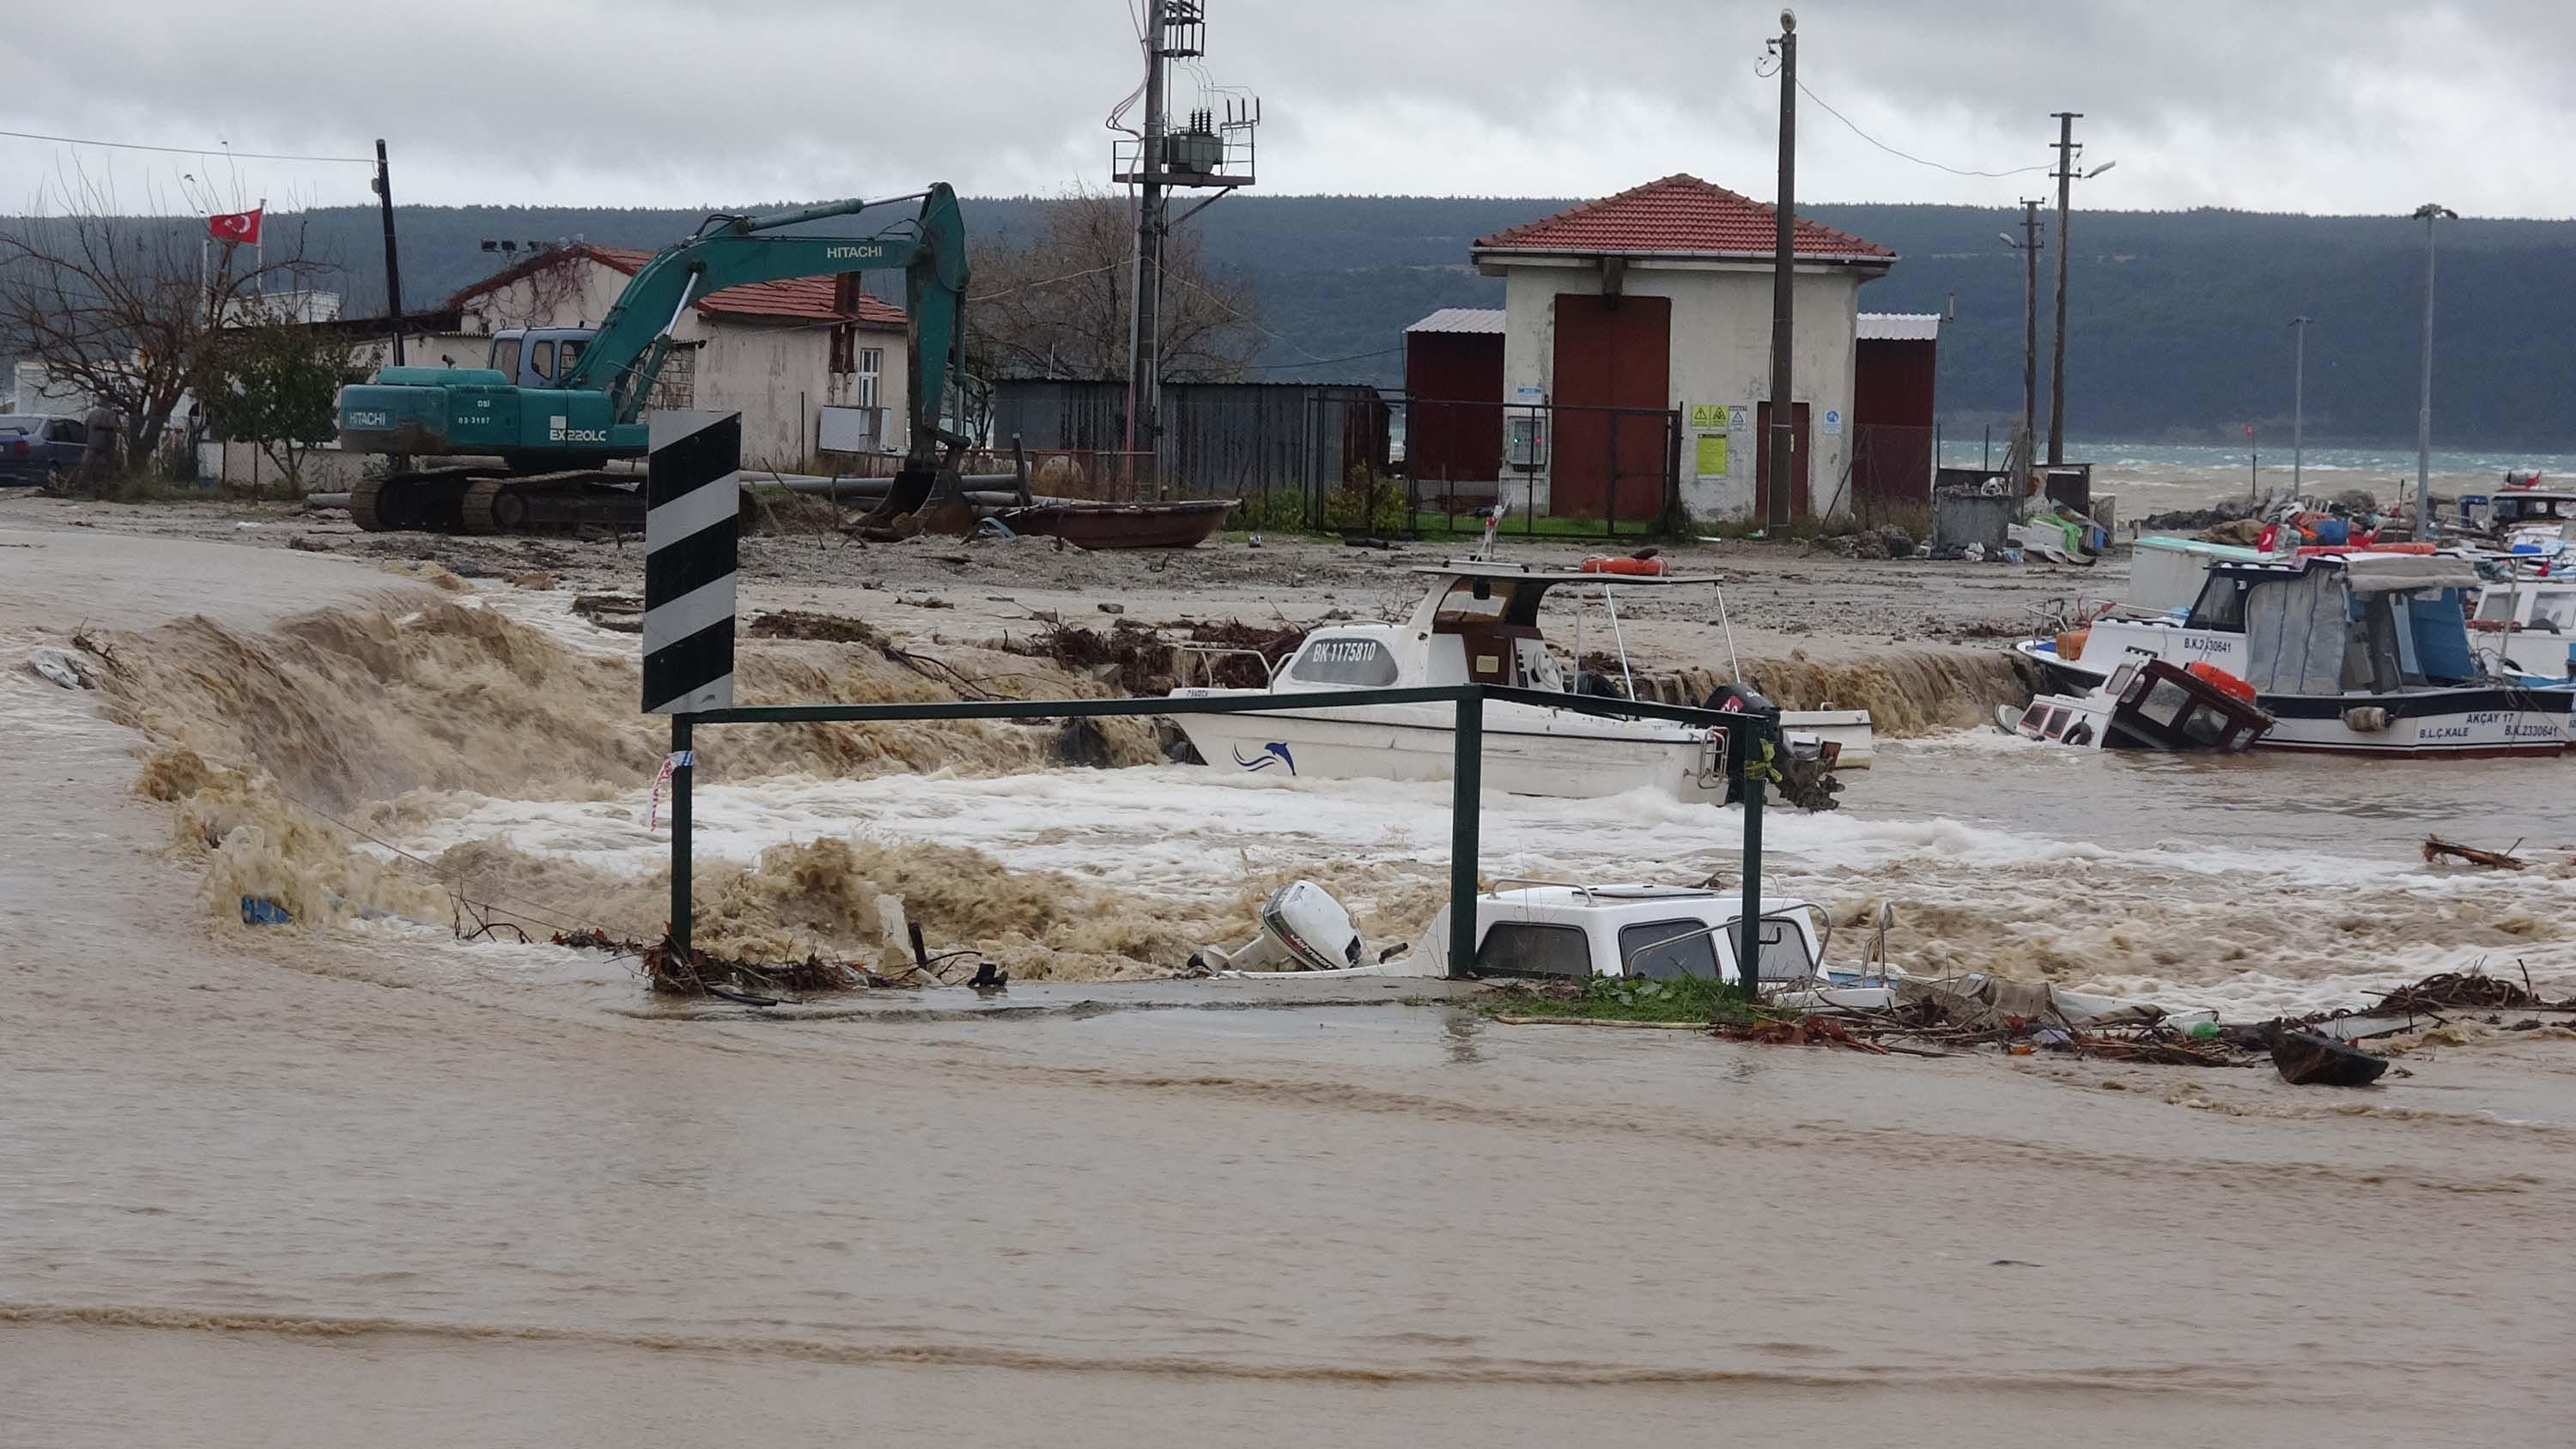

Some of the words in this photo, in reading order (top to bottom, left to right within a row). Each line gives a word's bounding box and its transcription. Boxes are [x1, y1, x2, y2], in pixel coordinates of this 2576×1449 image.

[827, 246, 883, 258] HITACHI
[349, 412, 386, 426] HITACHI
[1313, 644, 1329, 663] BK
[1330, 642, 1376, 663] 1175810
[2466, 713, 2500, 725] AKÇAY
[2503, 712, 2514, 722] 17
[1290, 934, 1334, 969] Johnson
